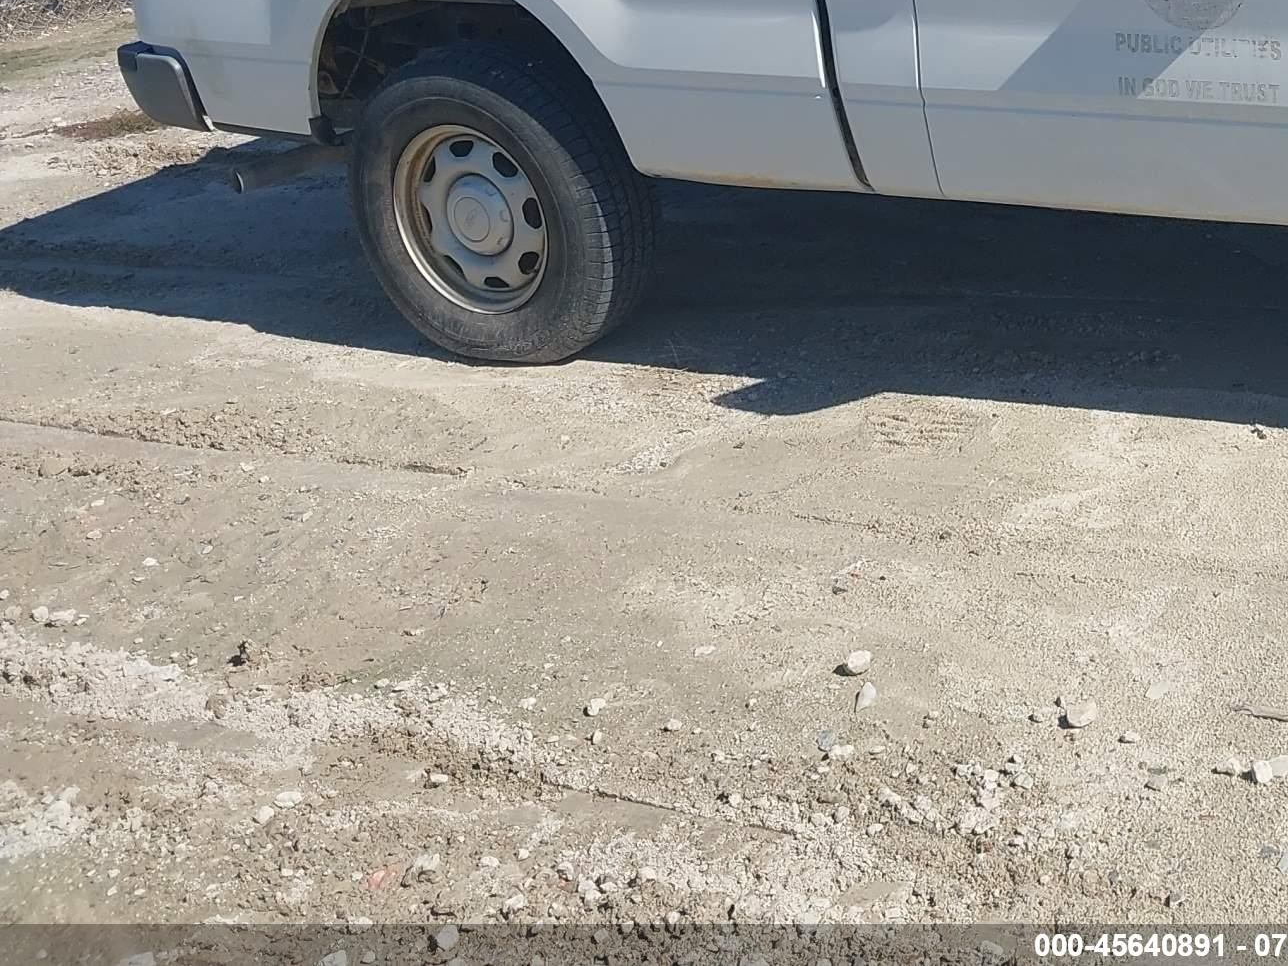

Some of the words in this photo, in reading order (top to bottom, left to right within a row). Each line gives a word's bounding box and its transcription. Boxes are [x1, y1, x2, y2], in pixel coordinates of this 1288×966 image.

[1115, 33, 1183, 55] PUBLIC
[1189, 36, 1282, 60] UTILIES
[1117, 76, 1137, 97] IN
[1144, 77, 1181, 98] GOD
[1185, 80, 1215, 100] WE
[1219, 81, 1281, 104] TRUST
